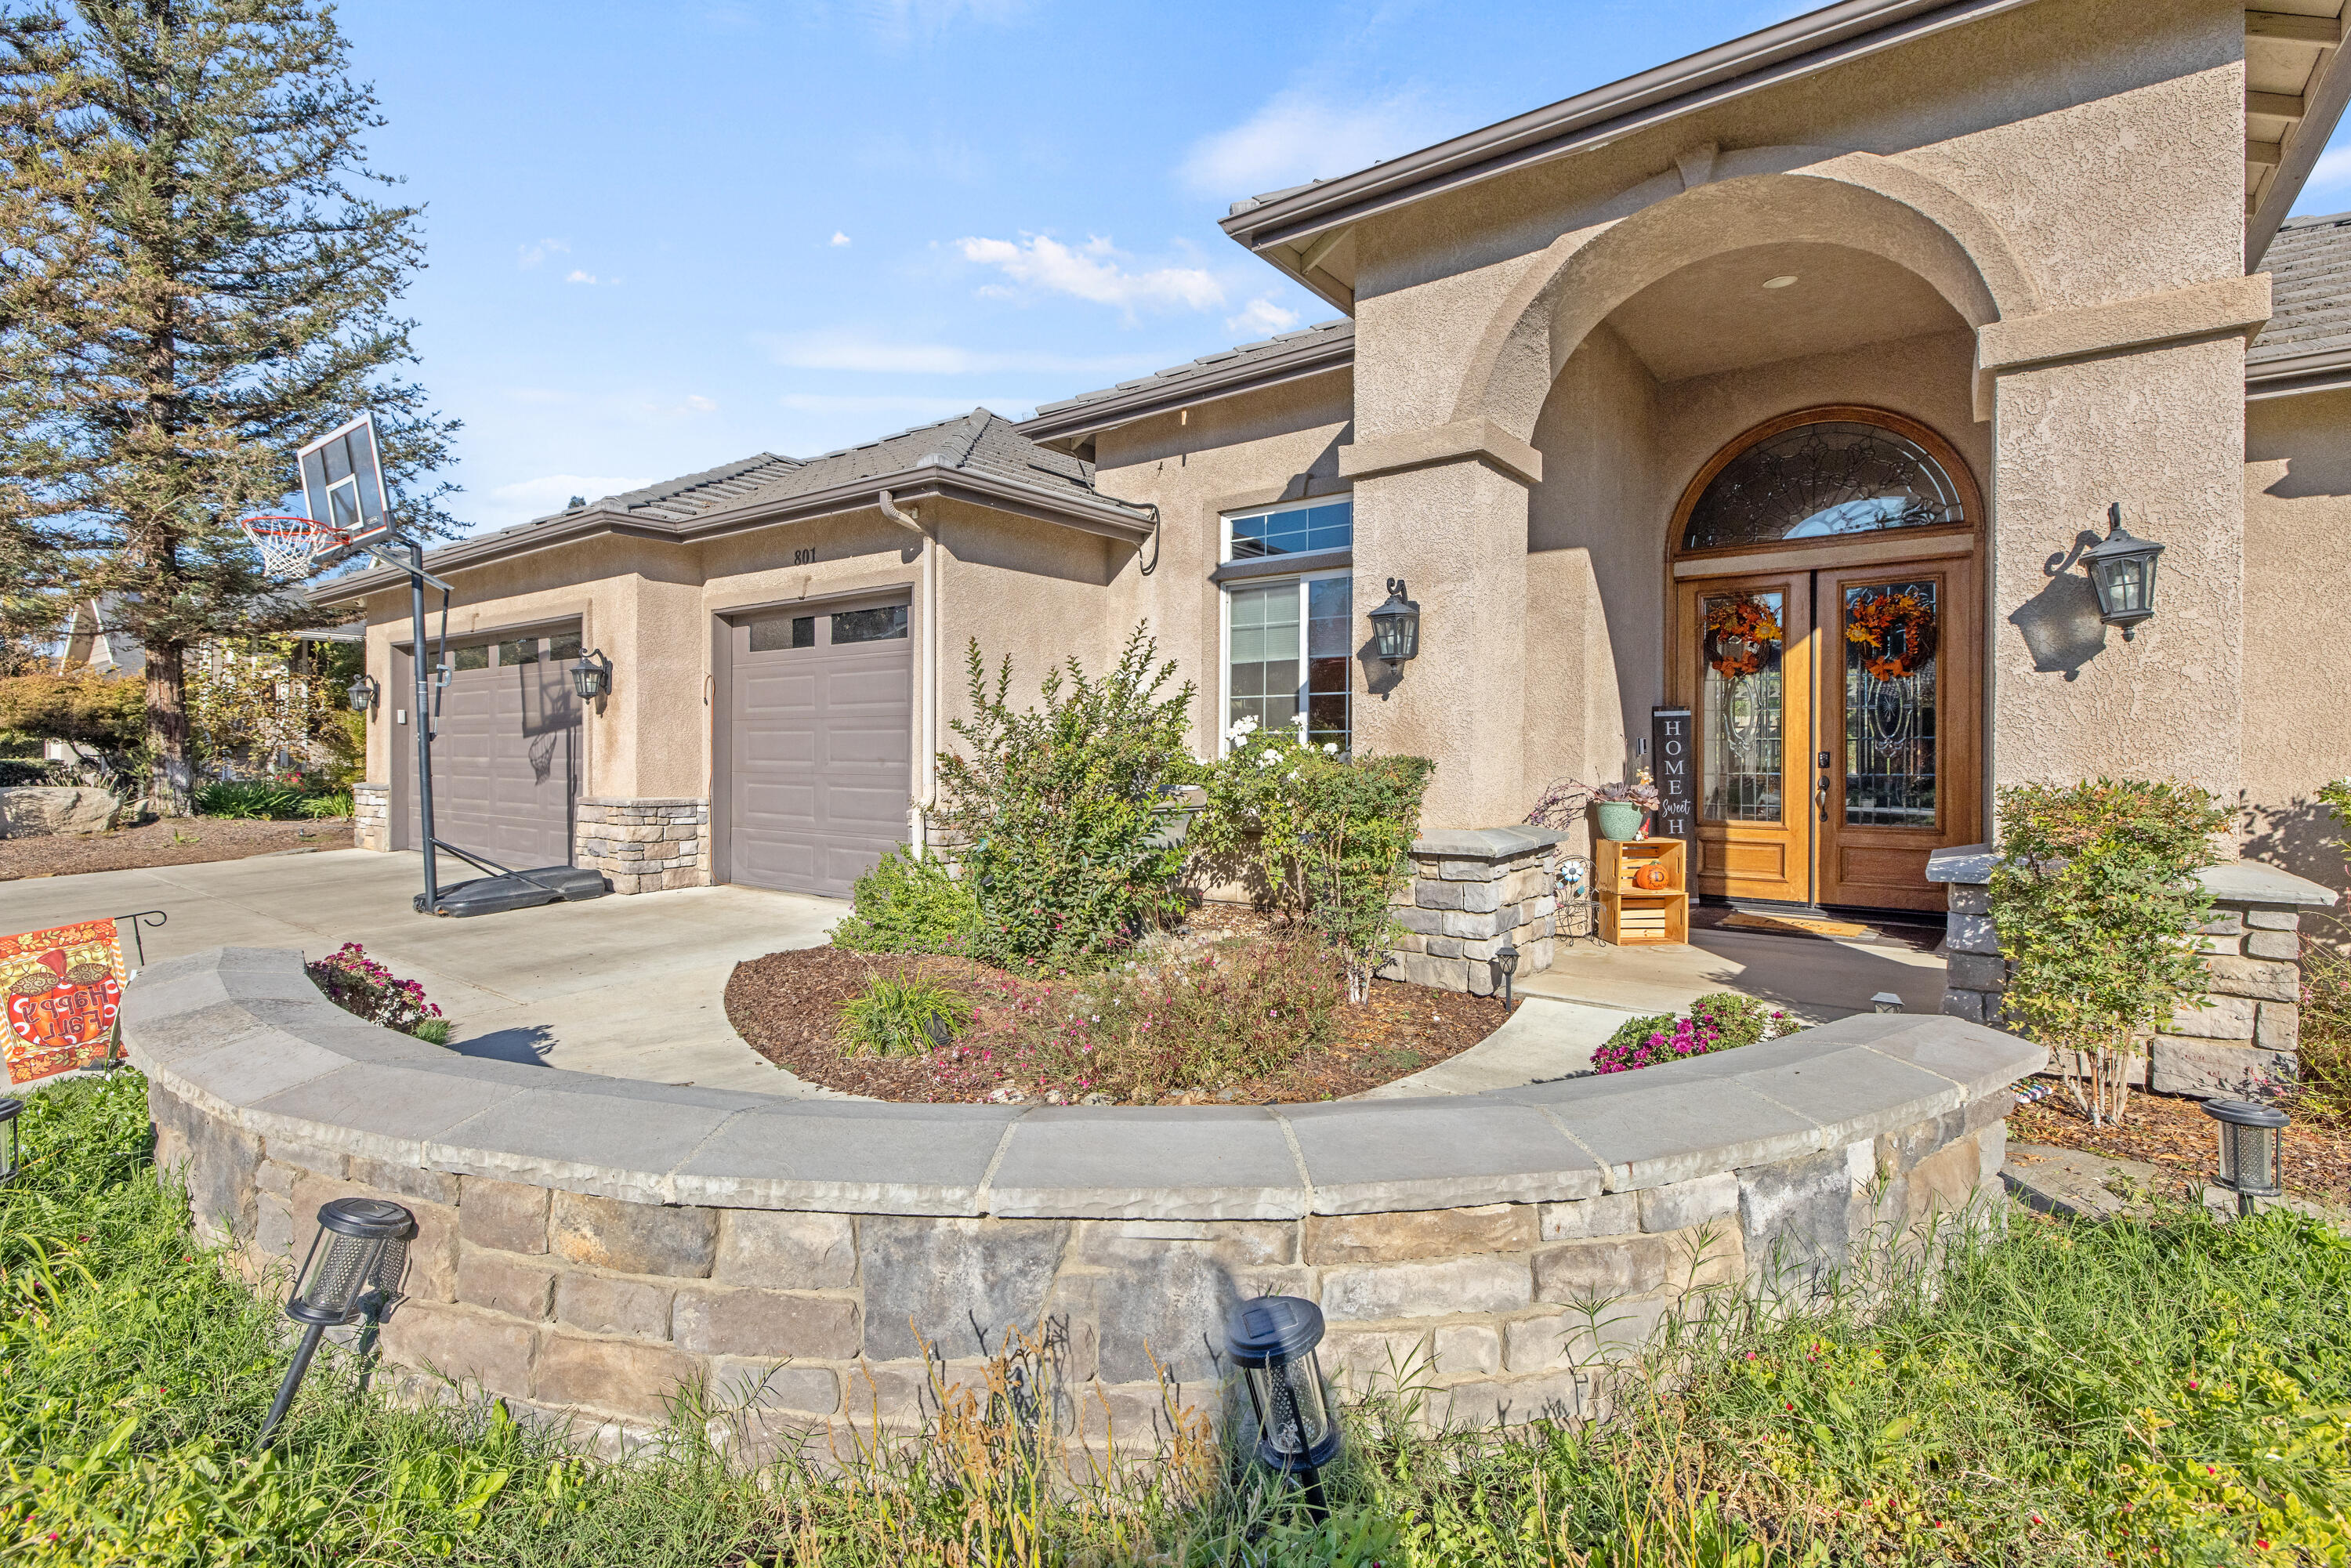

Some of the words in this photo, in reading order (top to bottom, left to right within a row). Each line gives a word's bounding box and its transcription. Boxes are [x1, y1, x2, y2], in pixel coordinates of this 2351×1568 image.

[795, 547, 815, 566] 801
[1665, 721, 1684, 795] HOME
[1655, 871, 1665, 882] D
